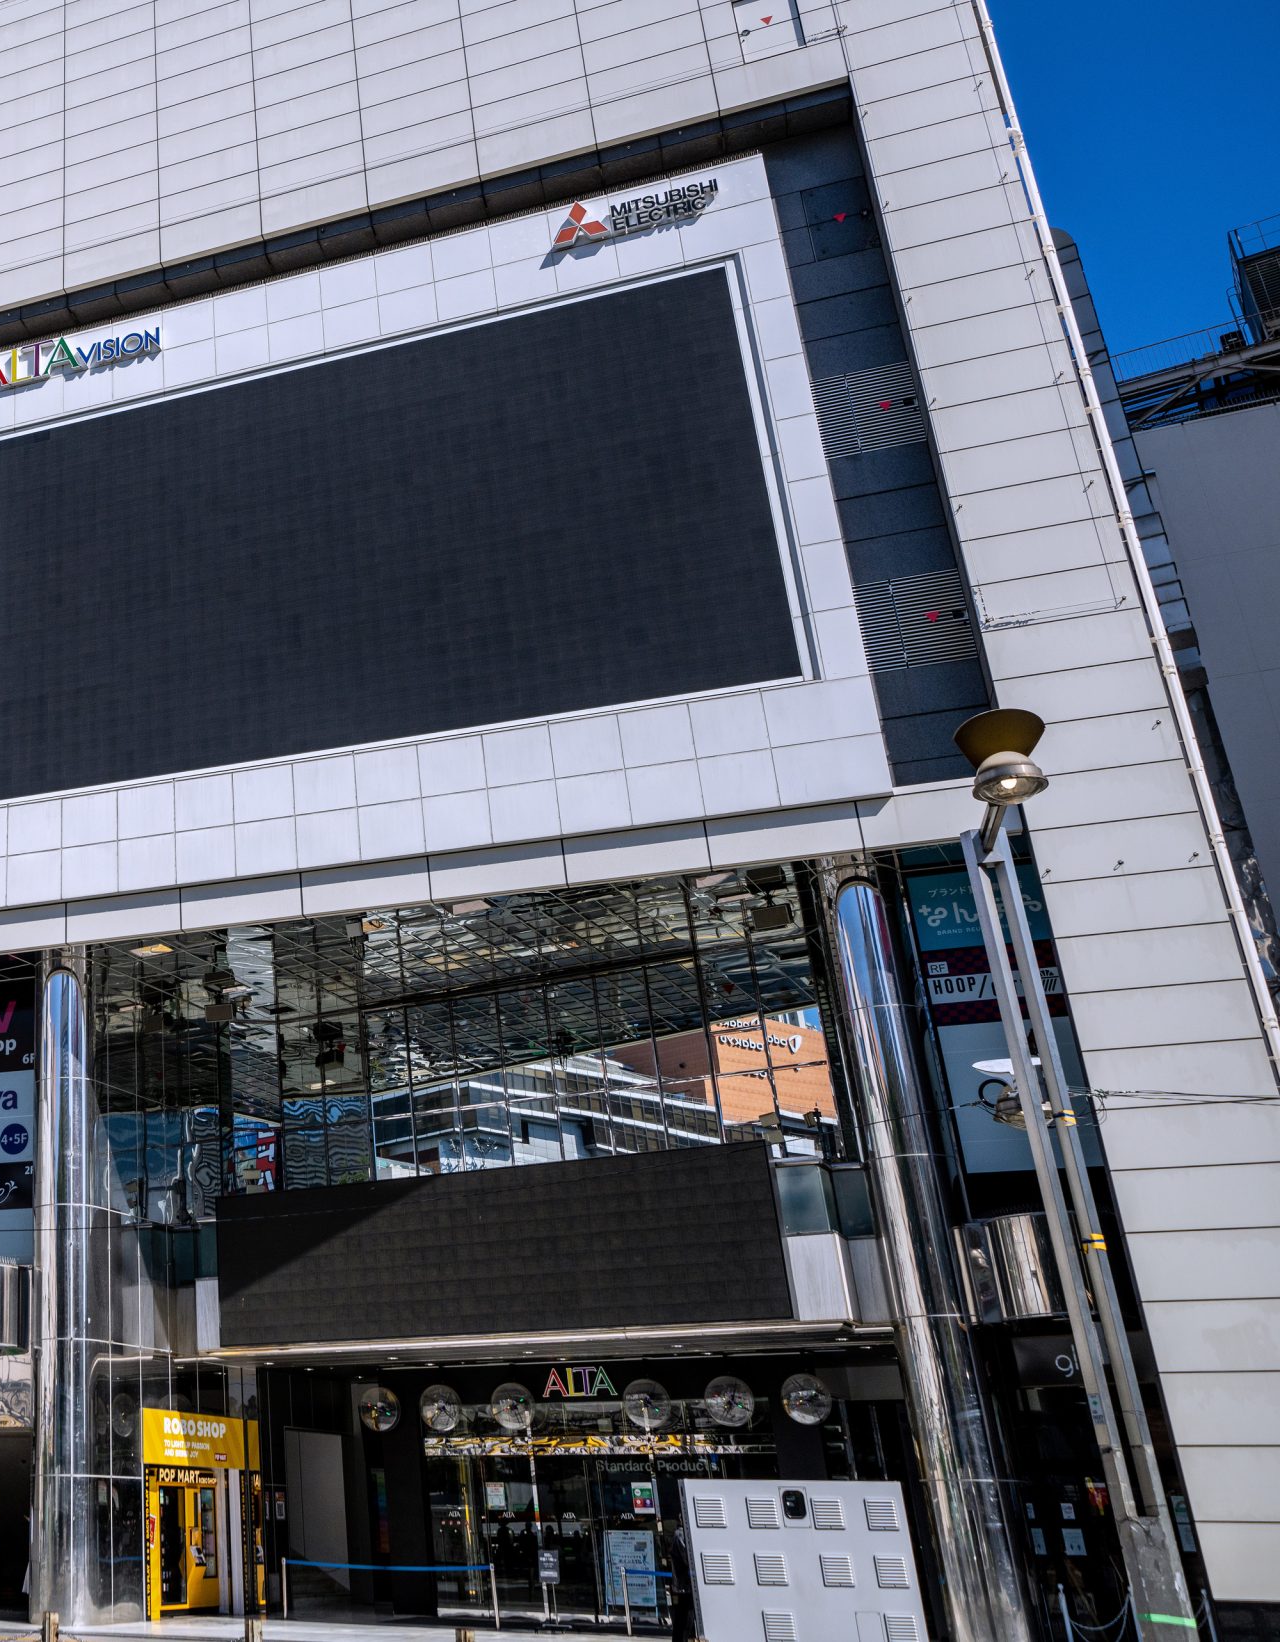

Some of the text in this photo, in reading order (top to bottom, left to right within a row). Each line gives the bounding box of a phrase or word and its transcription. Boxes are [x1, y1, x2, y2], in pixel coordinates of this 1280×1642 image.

[610, 178, 719, 219] MITSUBISHI
[613, 196, 707, 231] ELECTRIC
[930, 963, 946, 973] RF
[22, 1053, 35, 1065] 6F
[543, 1366, 618, 1397] ALTA
[163, 1416, 226, 1438] ROBO SHOP
[164, 1439, 170, 1448] TO
[164, 1449, 174, 1457] AND
[190, 1450, 199, 1459] JOY
[159, 1468, 175, 1482] POP
[177, 1469, 200, 1485] MART
[448, 1510, 461, 1518] ALTA
[620, 1512, 634, 1520] ALTA
